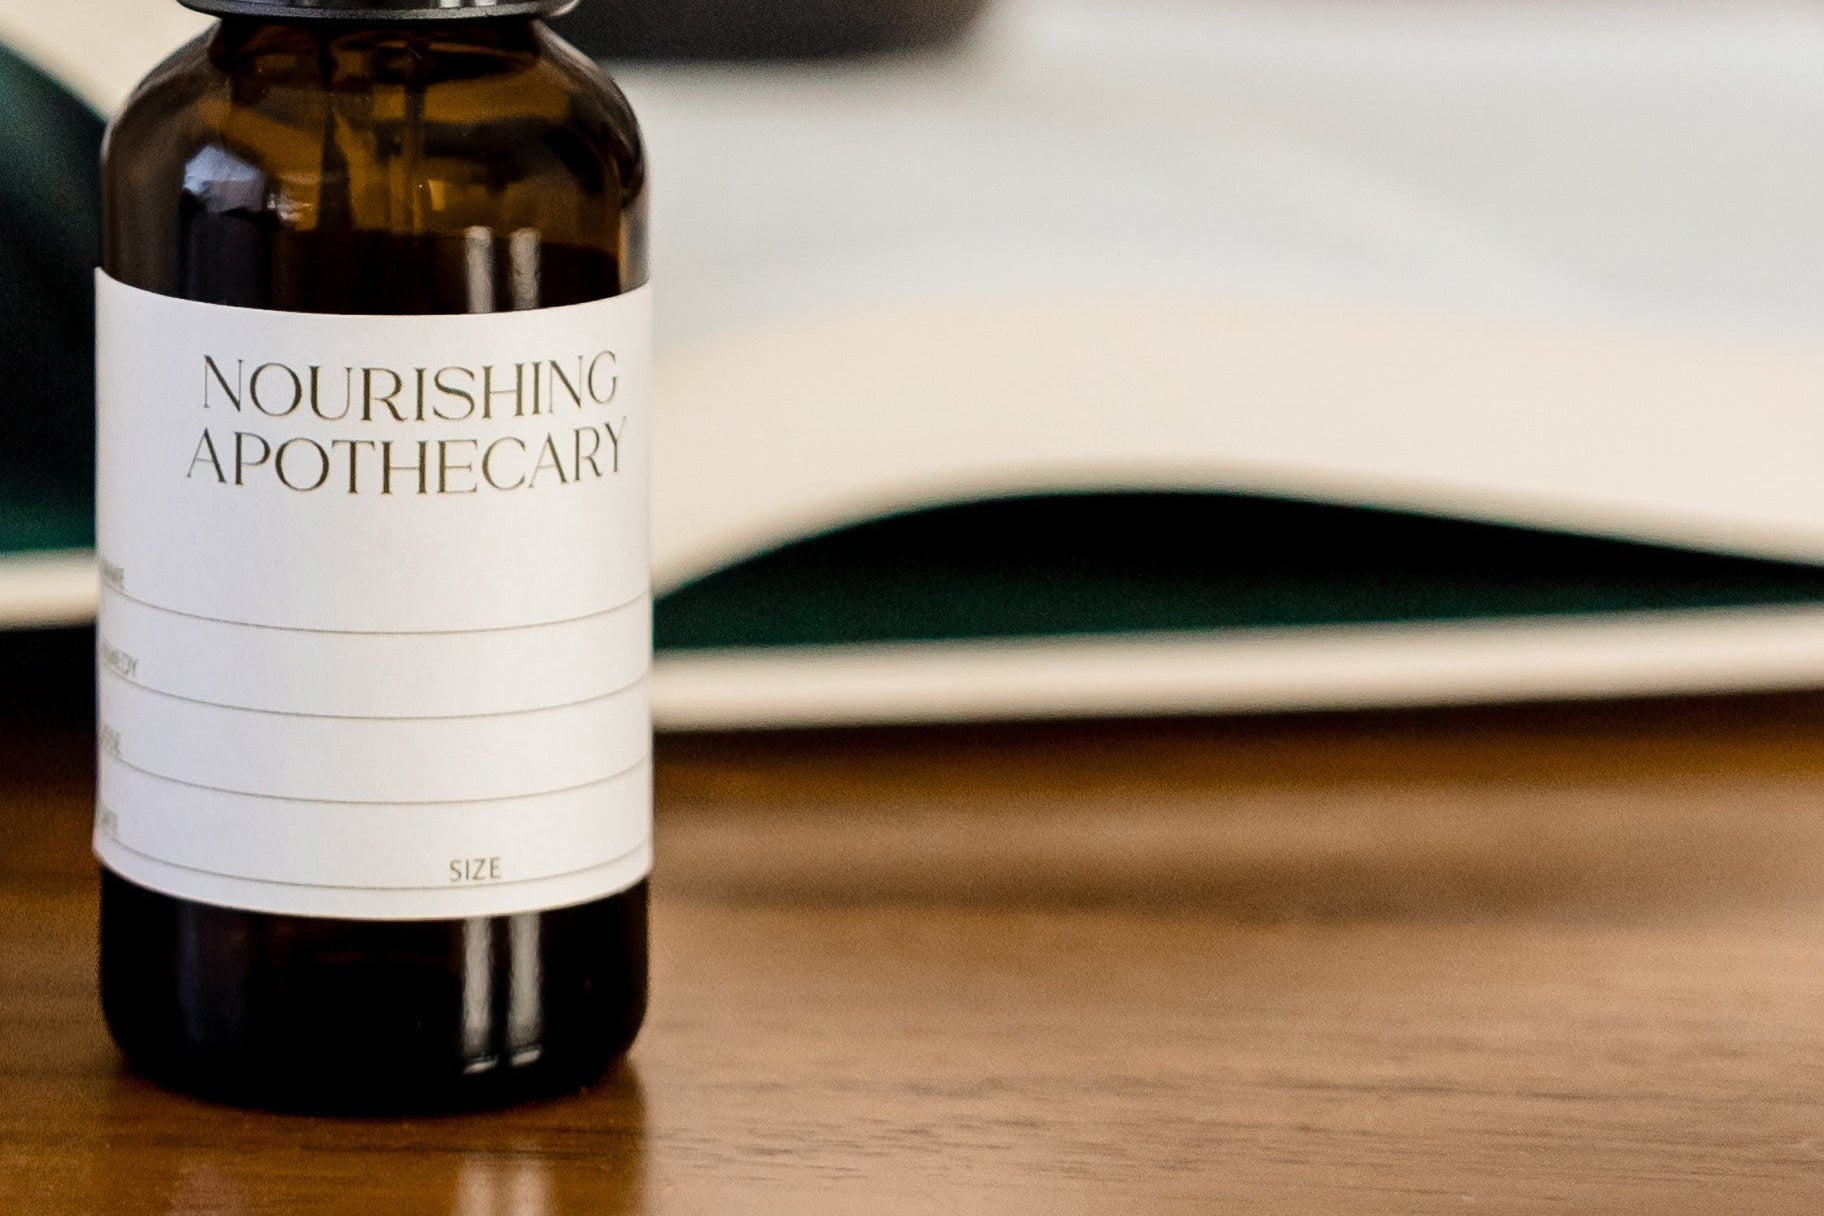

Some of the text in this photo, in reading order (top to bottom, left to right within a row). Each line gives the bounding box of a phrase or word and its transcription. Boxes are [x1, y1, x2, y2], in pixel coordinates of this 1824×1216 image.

[203, 349, 620, 423] NOURISHING
[186, 416, 629, 496] APOTHECARY
[449, 857, 502, 882] SIZE
